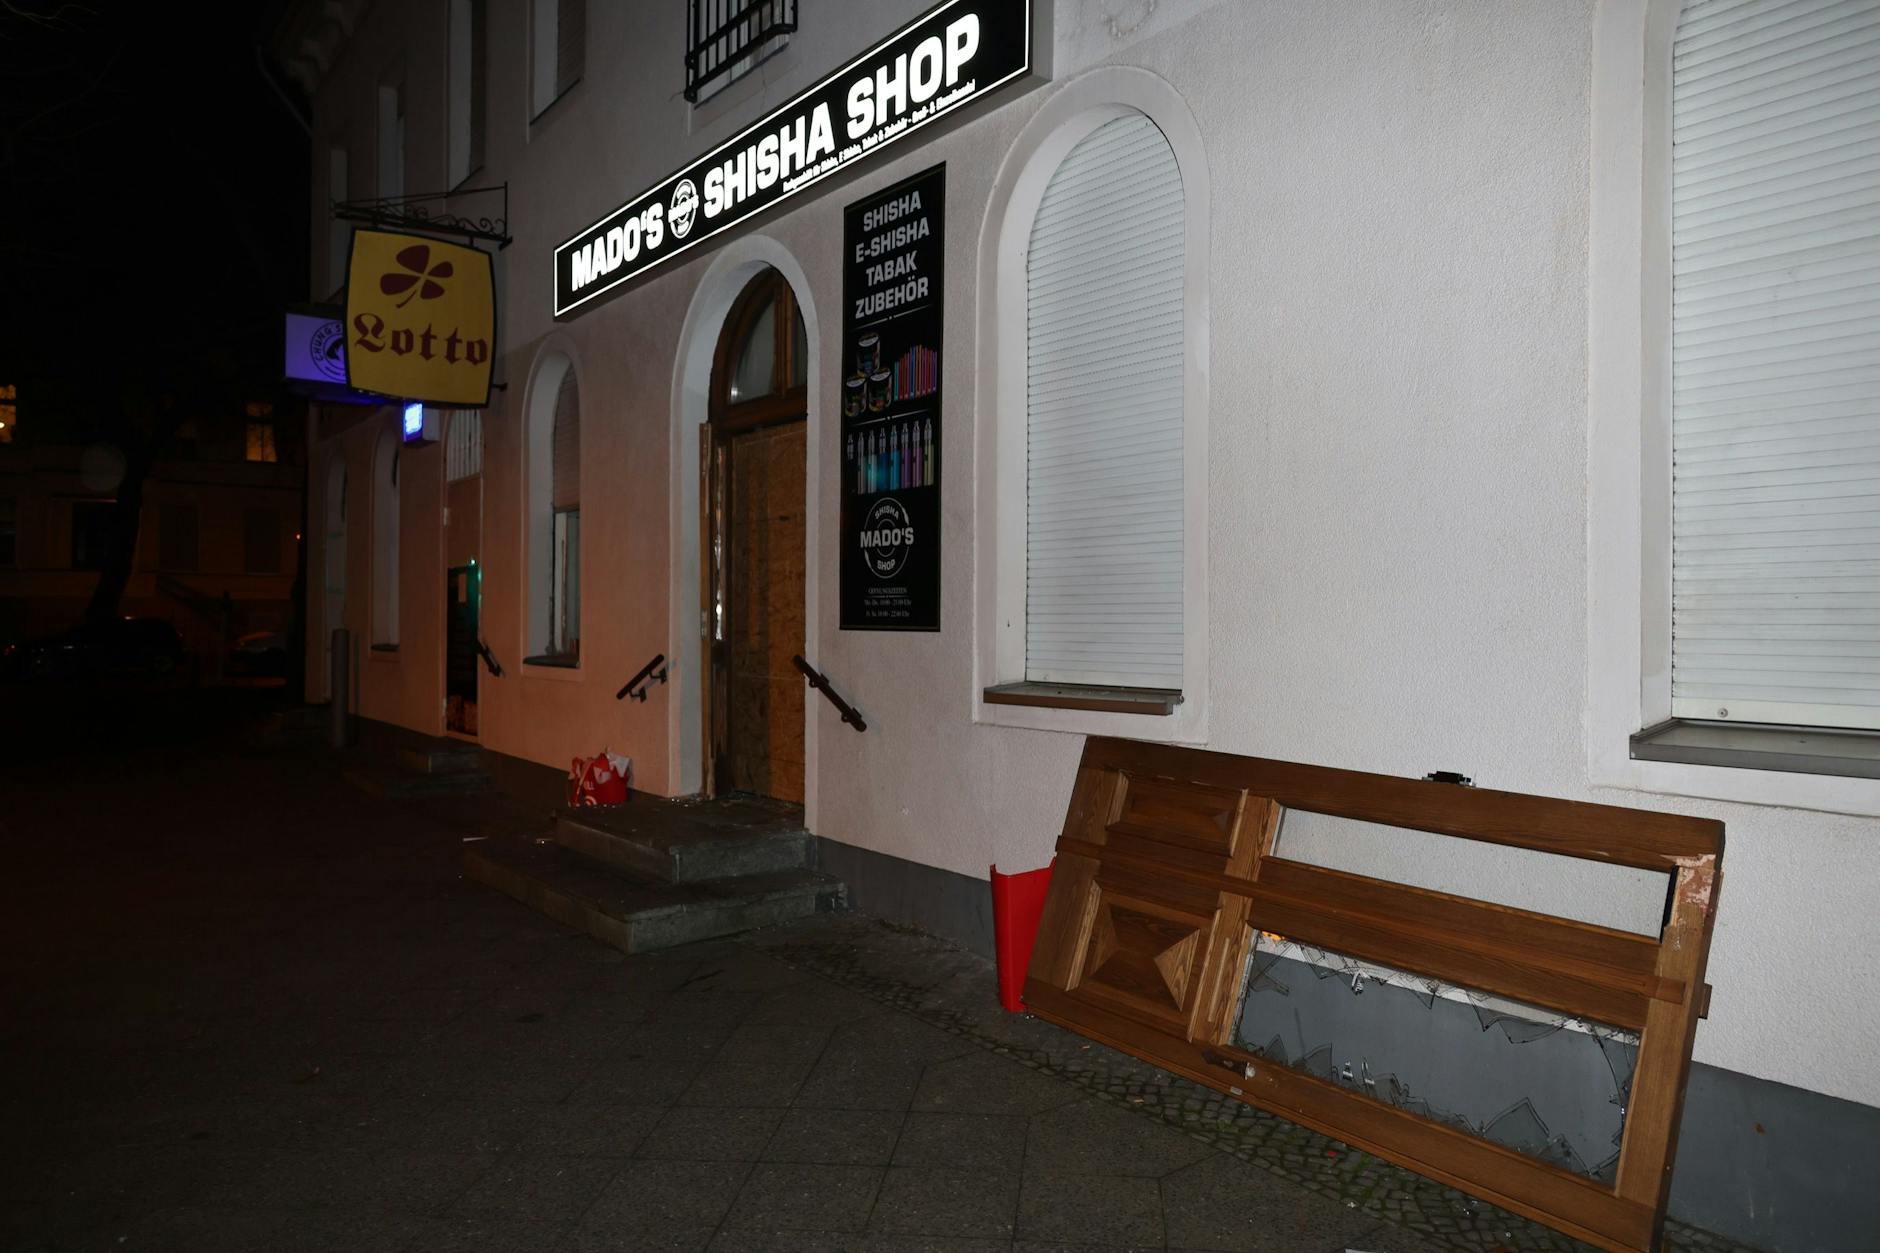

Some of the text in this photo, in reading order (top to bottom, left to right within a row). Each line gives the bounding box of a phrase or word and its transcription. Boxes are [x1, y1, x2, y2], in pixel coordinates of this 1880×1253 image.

[572, 13, 980, 292] MADO'S SHISHA SHOP
[863, 190, 922, 232] SHISHA
[855, 216, 930, 263] E-SHISHA
[865, 250, 918, 287] TABAK
[855, 275, 929, 319] ZUBEHÖR
[353, 312, 489, 366] Lotto
[874, 505, 900, 521] SHISHA
[860, 527, 915, 549] MADO'S
[877, 558, 896, 571] SHOP
